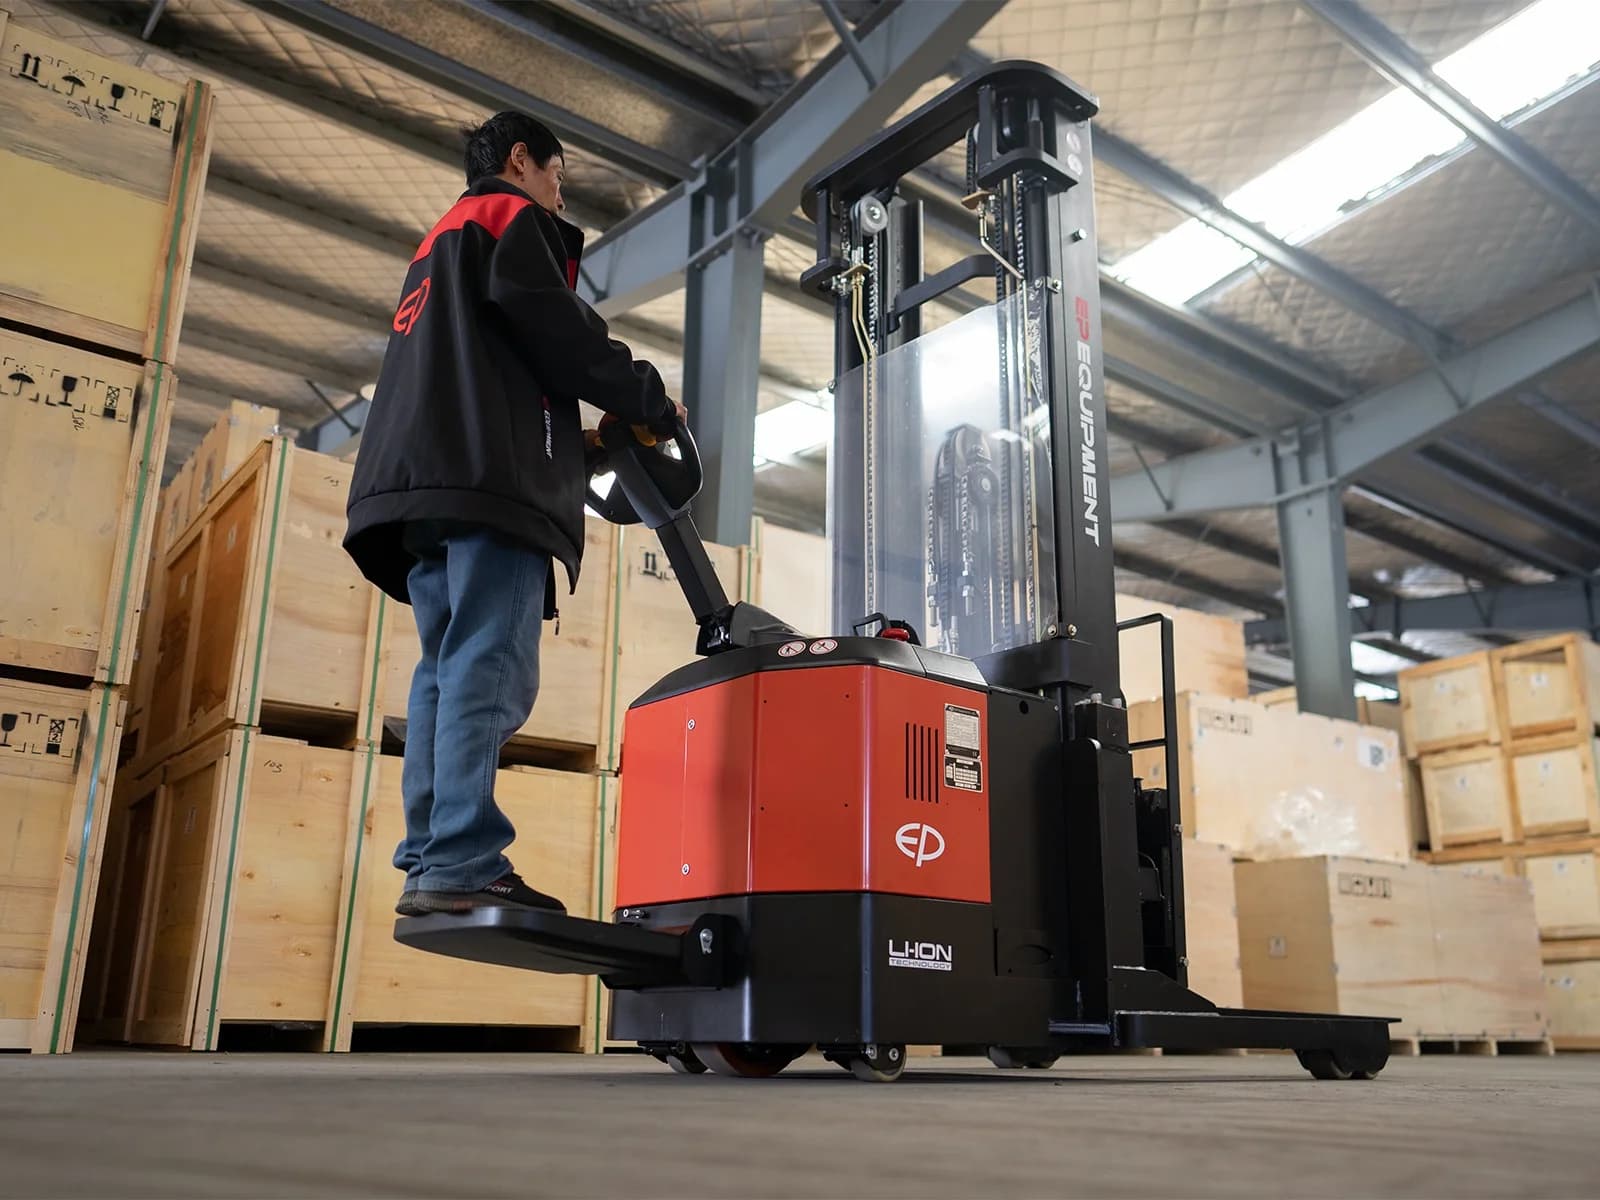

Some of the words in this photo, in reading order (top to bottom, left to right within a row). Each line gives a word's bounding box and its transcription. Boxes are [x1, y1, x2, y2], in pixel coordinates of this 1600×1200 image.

[393, 276, 431, 336] EP
[1075, 296, 1090, 340] EP
[1077, 340, 1100, 547] EQUIPMENT
[895, 822, 946, 868] EP
[889, 958, 952, 970] TECHNOLOGY
